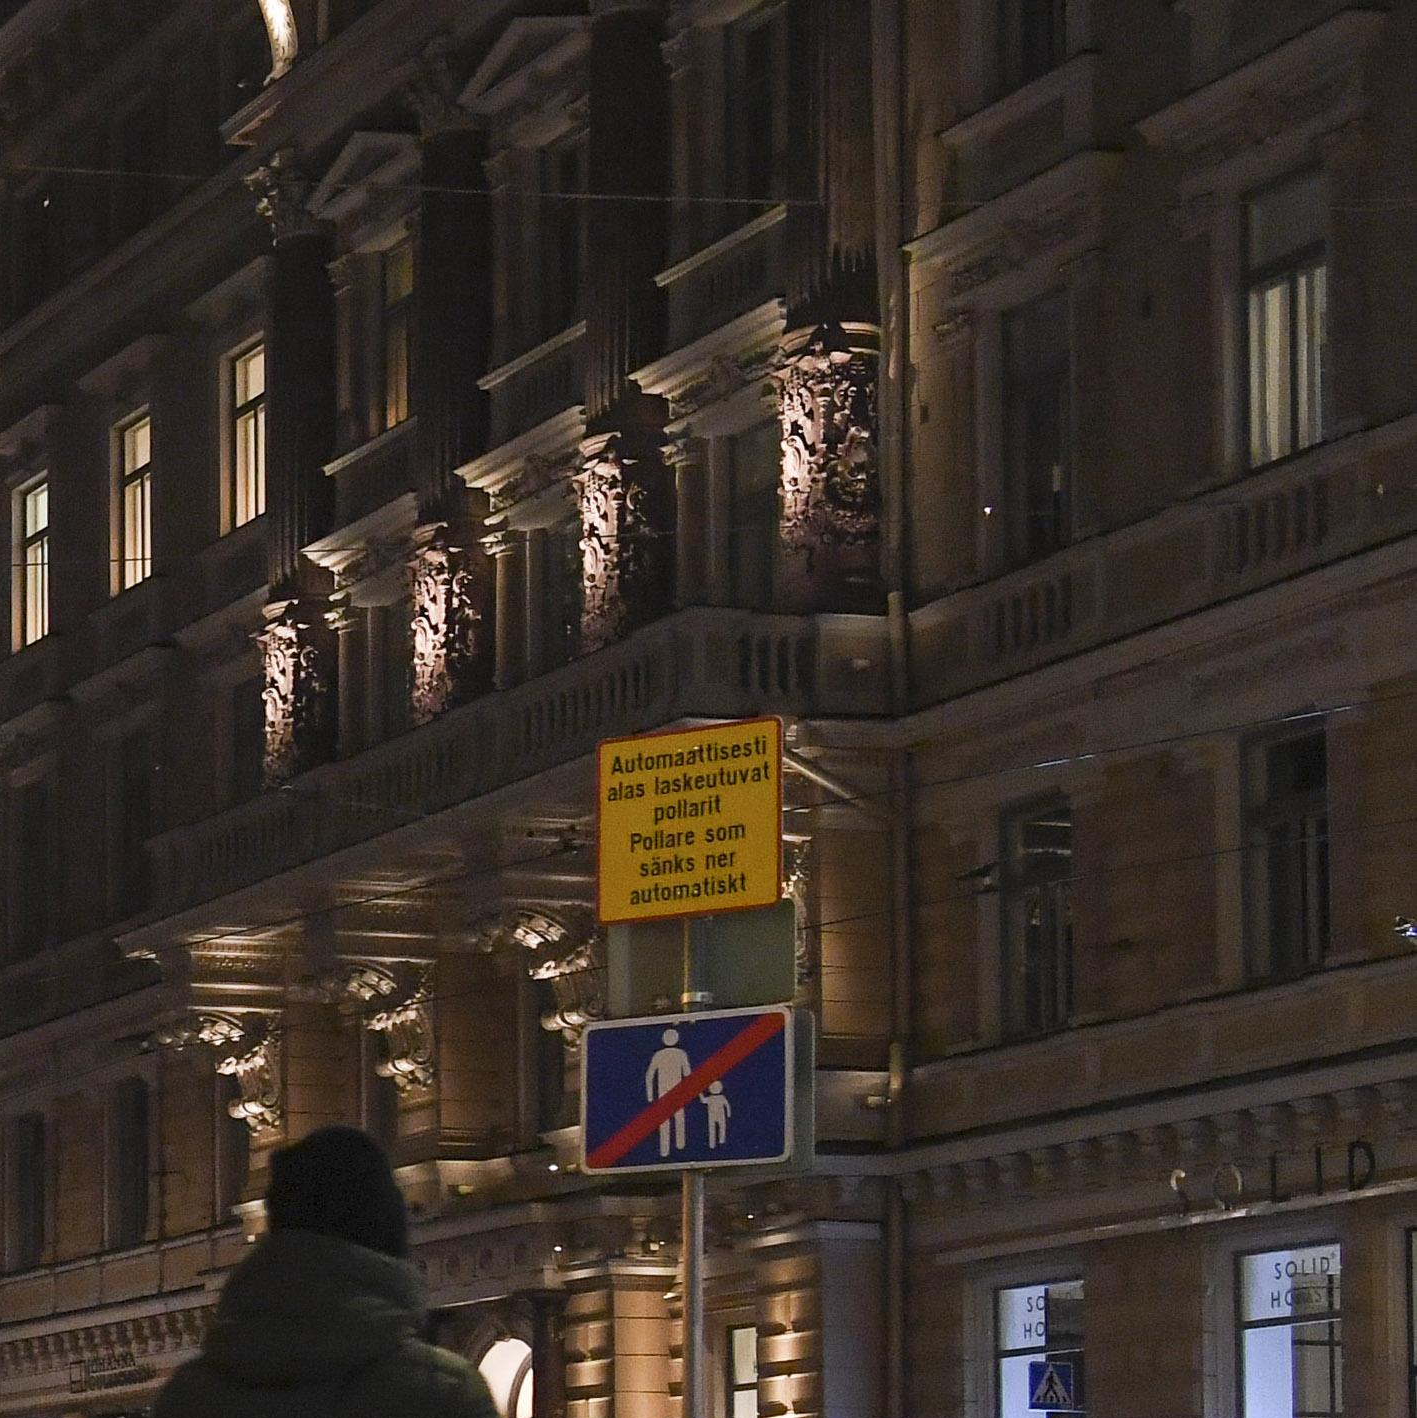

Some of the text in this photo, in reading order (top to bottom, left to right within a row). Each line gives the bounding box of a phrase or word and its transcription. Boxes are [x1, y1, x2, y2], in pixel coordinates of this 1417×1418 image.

[611, 735, 767, 775] Automaattisesti
[607, 764, 770, 801] alas laskeutuvat
[654, 797, 721, 825] pollarit
[630, 824, 745, 853] Pollare som
[640, 851, 736, 877] sänks ner
[630, 872, 747, 905] automatiskt
[1170, 1141, 1376, 1217] SOLID
[1274, 1257, 1330, 1280] SOLID
